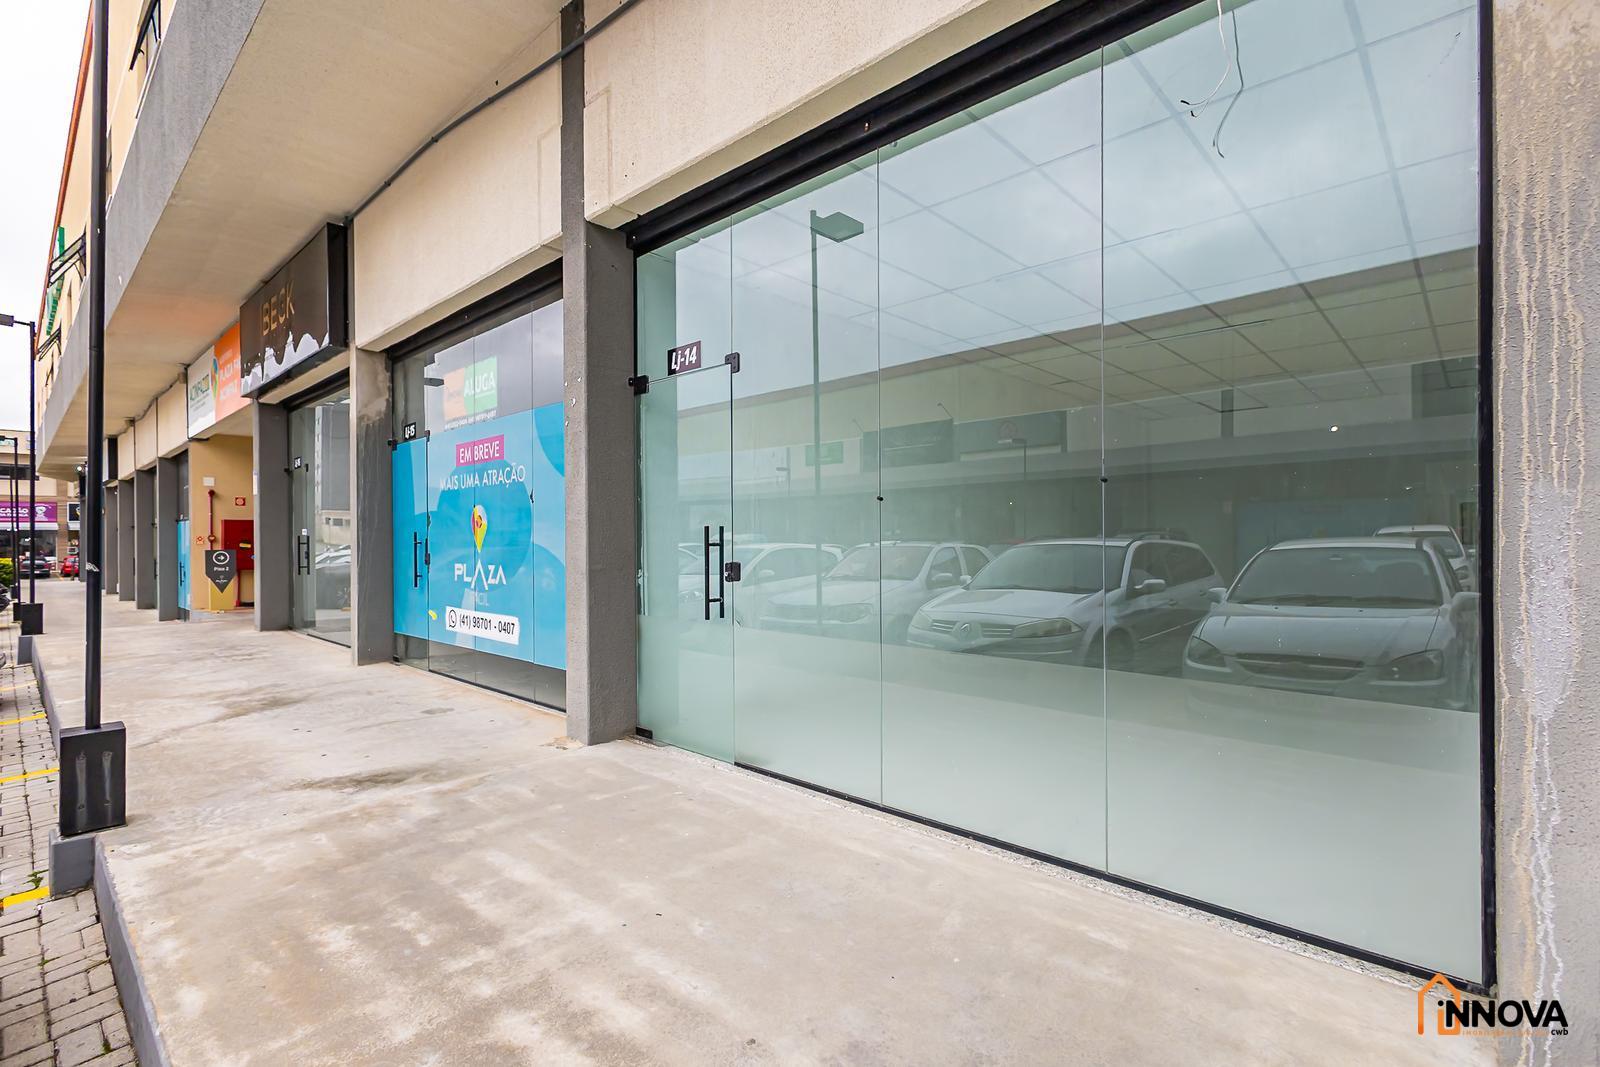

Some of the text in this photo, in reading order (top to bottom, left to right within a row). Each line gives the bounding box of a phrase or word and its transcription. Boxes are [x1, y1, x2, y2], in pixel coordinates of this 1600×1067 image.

[262, 280, 295, 336] BECK
[671, 345, 697, 371] Lj-14
[463, 371, 496, 397] ALUGA
[459, 440, 500, 463] EM BREVE
[440, 463, 526, 491] MAIS UMA ATRAÇÃO
[454, 559, 507, 591] PLAZA
[459, 614, 472, 630] (41)
[472, 617, 493, 632] 98701
[498, 621, 515, 636] 0407
